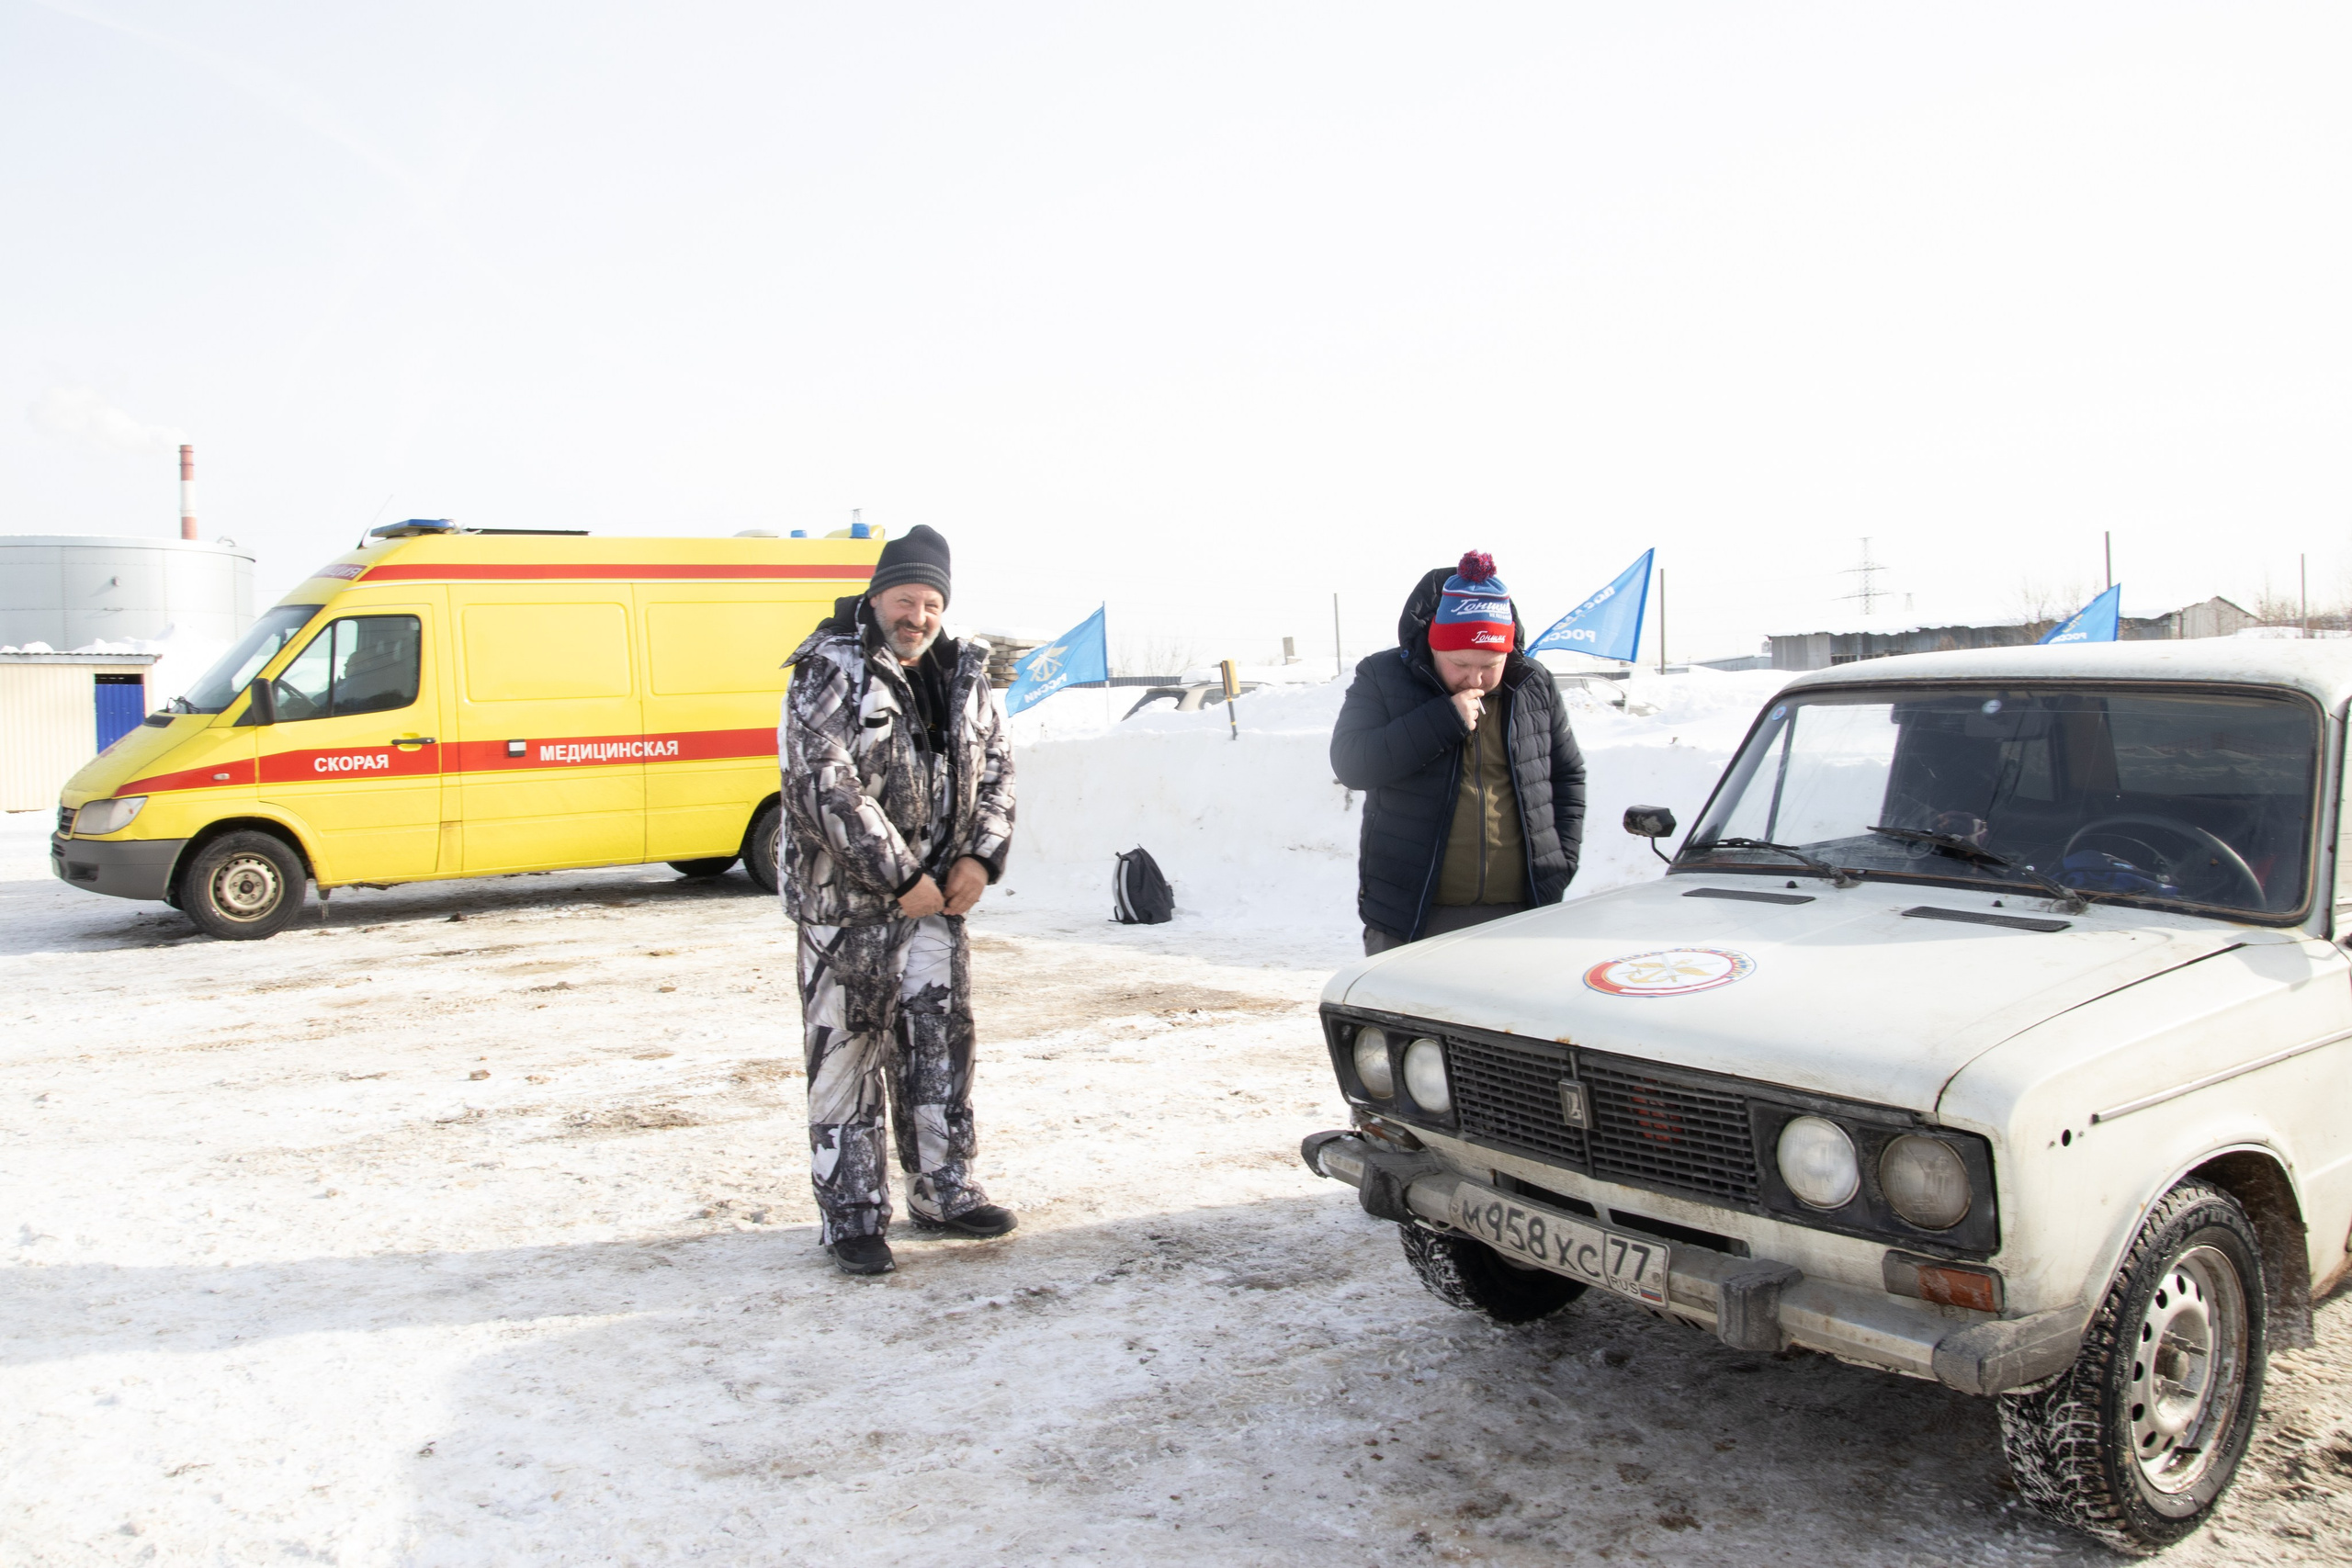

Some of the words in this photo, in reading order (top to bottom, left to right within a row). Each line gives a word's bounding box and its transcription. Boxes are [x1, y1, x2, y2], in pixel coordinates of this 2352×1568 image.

[314, 754, 390, 773] СКОРАЯ
[539, 739, 679, 761] МЕДИЦИНСКАЯ
[1611, 1238, 1651, 1281] 77
[1611, 1275, 1640, 1295] RUS
